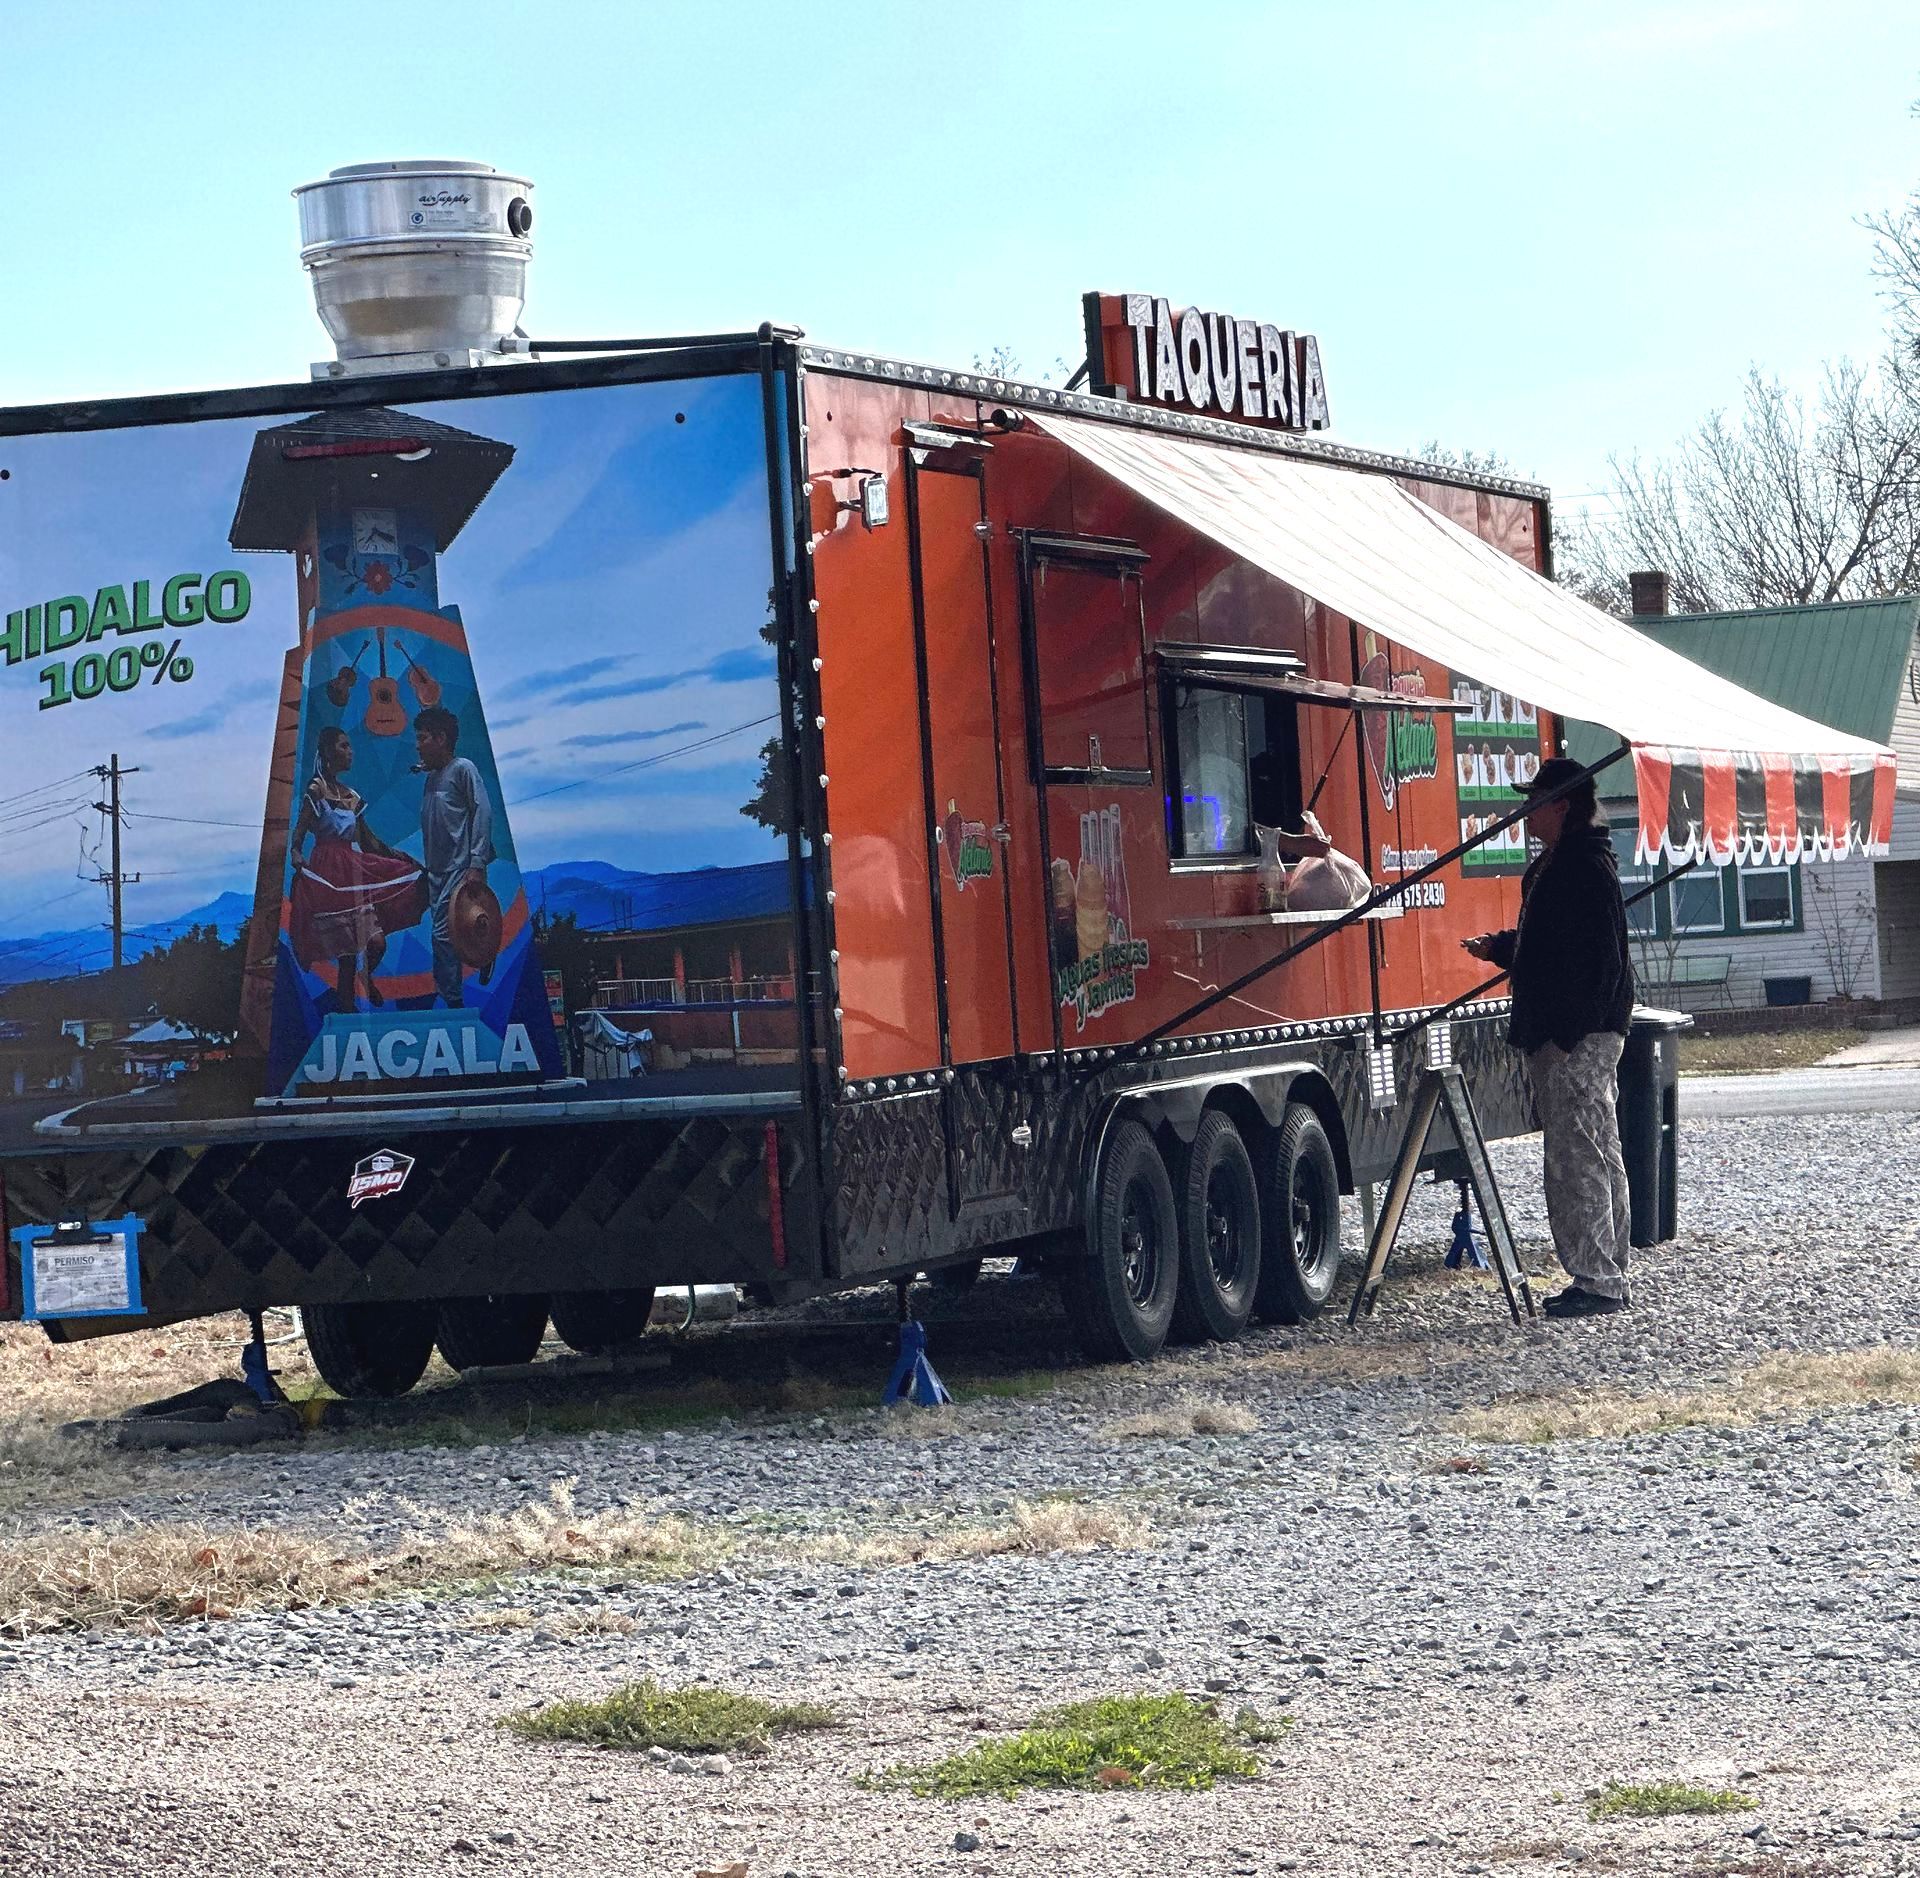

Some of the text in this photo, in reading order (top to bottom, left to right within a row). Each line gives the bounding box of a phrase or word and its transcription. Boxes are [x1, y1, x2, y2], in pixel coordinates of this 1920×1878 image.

[1121, 294, 1331, 431] TAQUERIA
[39, 639, 194, 711] 100%
[1404, 883, 1422, 908] 575
[1423, 882, 1446, 907] 2430
[304, 1023, 541, 1084] JACALA
[54, 1255, 95, 1267] PERMISO
